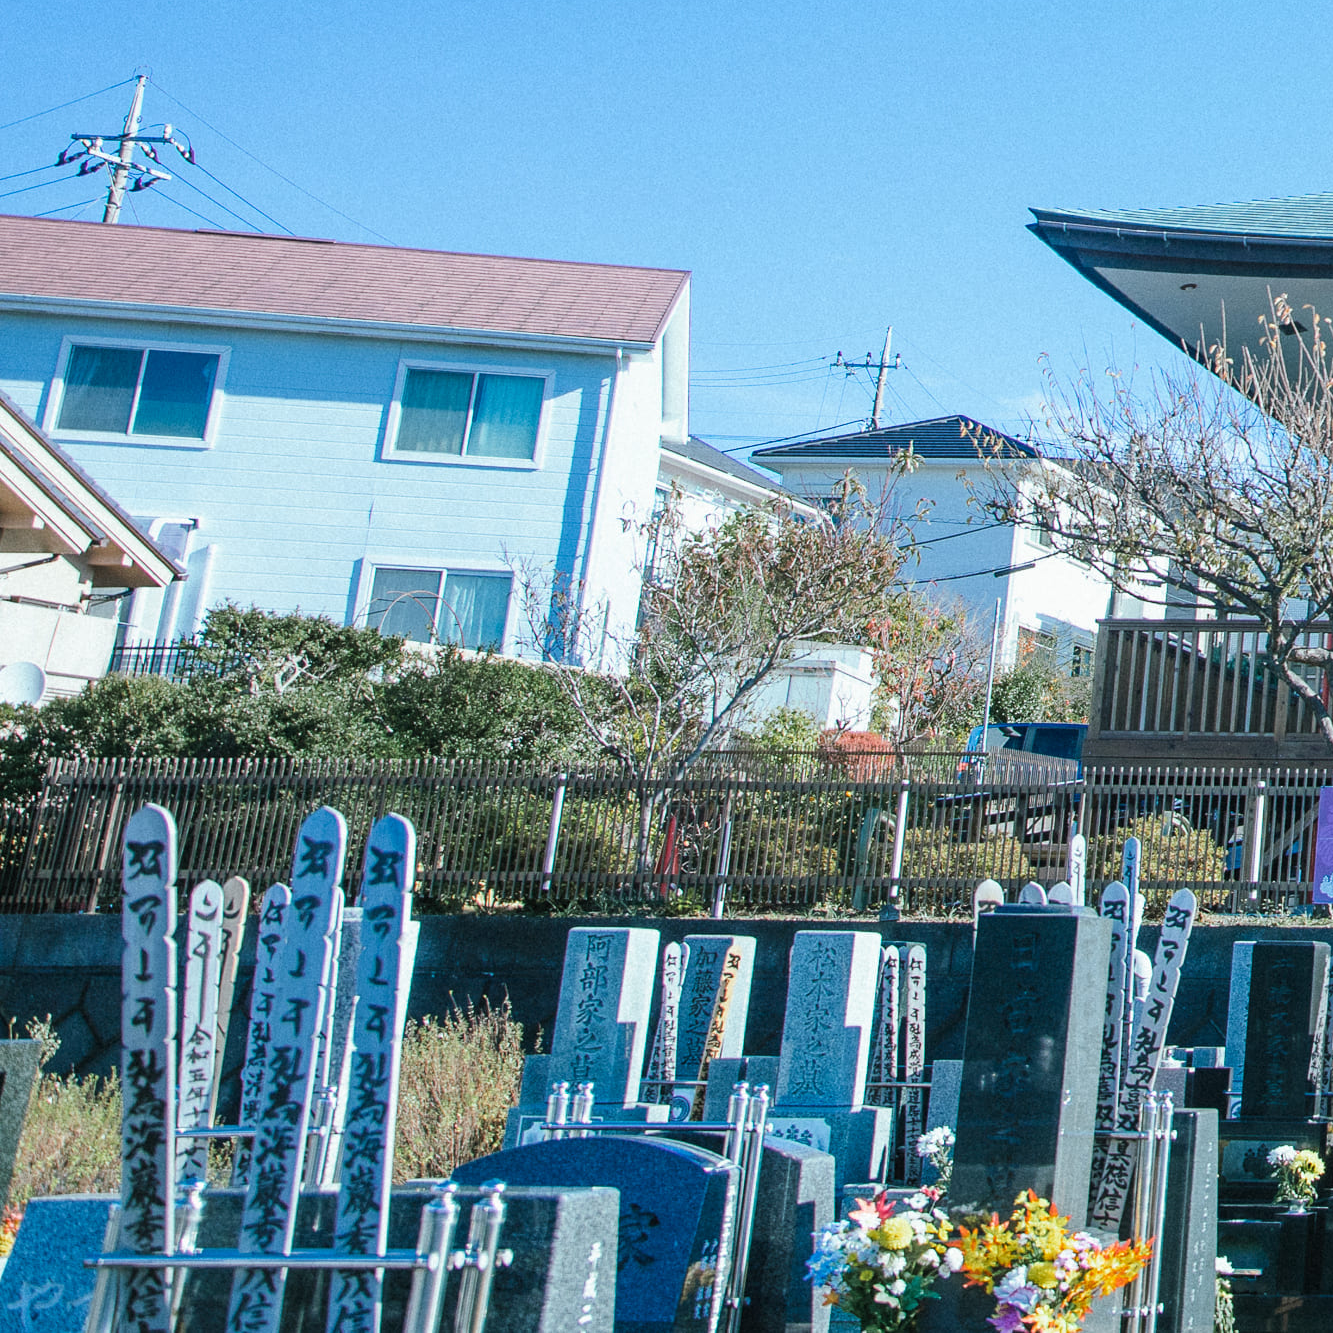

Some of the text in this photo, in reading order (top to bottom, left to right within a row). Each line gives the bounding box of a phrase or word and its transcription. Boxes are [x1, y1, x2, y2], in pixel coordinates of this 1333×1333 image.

[681, 945, 718, 1067] 加藤家之墓
